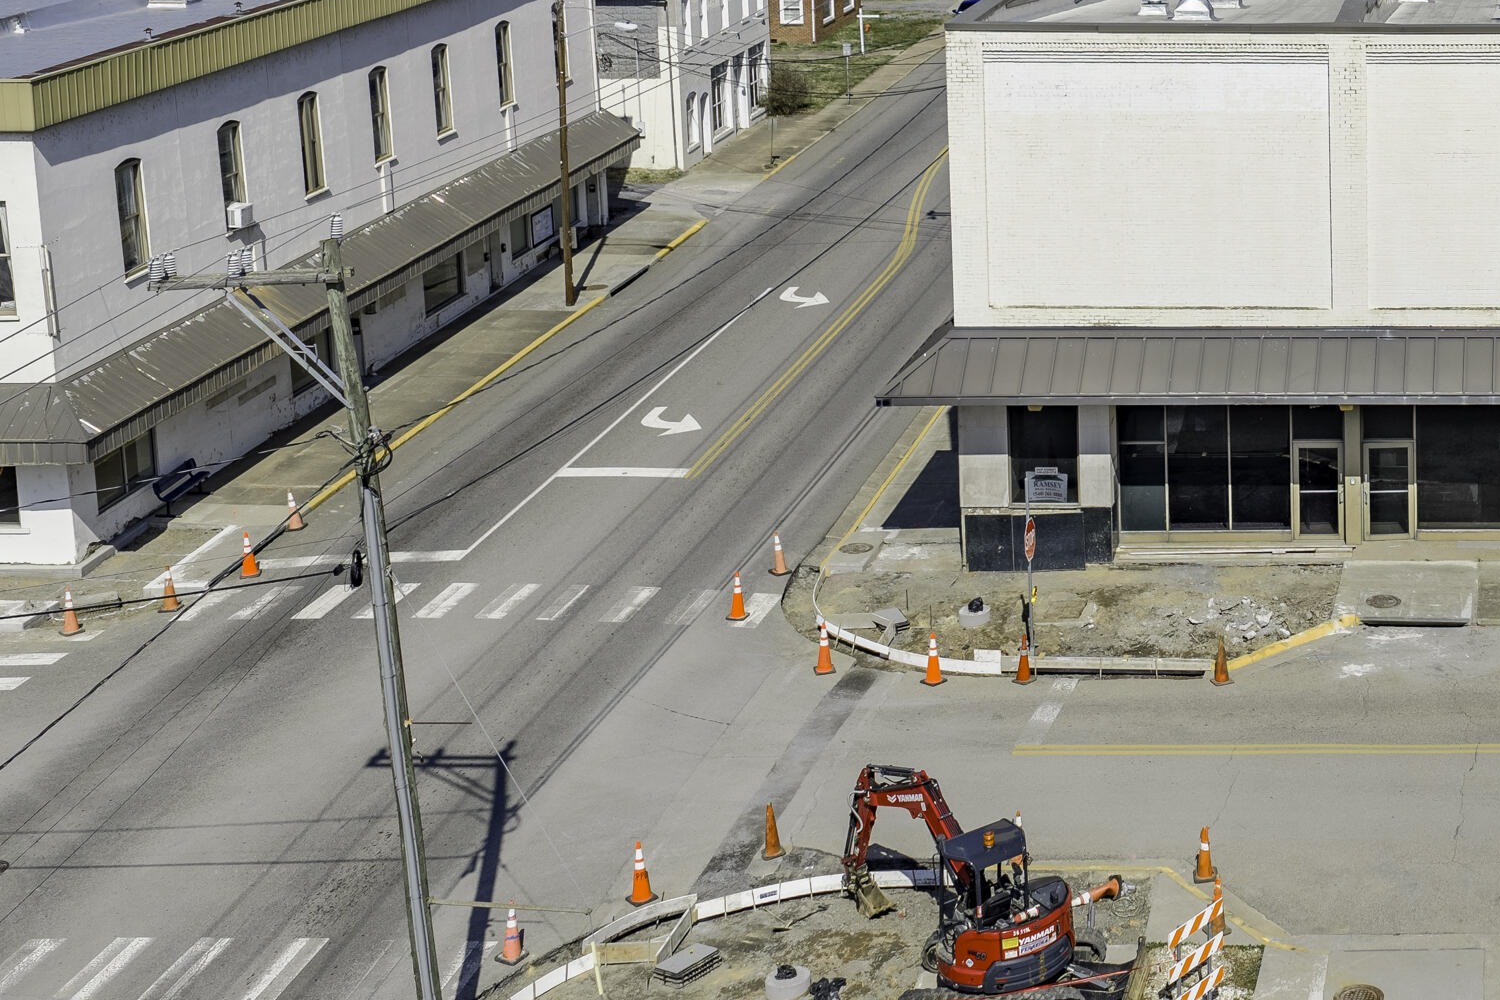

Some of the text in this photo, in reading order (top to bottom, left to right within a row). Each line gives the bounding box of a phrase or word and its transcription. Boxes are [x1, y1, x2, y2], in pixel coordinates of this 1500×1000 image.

[1033, 480, 1062, 489] RAMSEY
[897, 793, 924, 803] YANMAR
[1018, 925, 1055, 945] YANMAR
